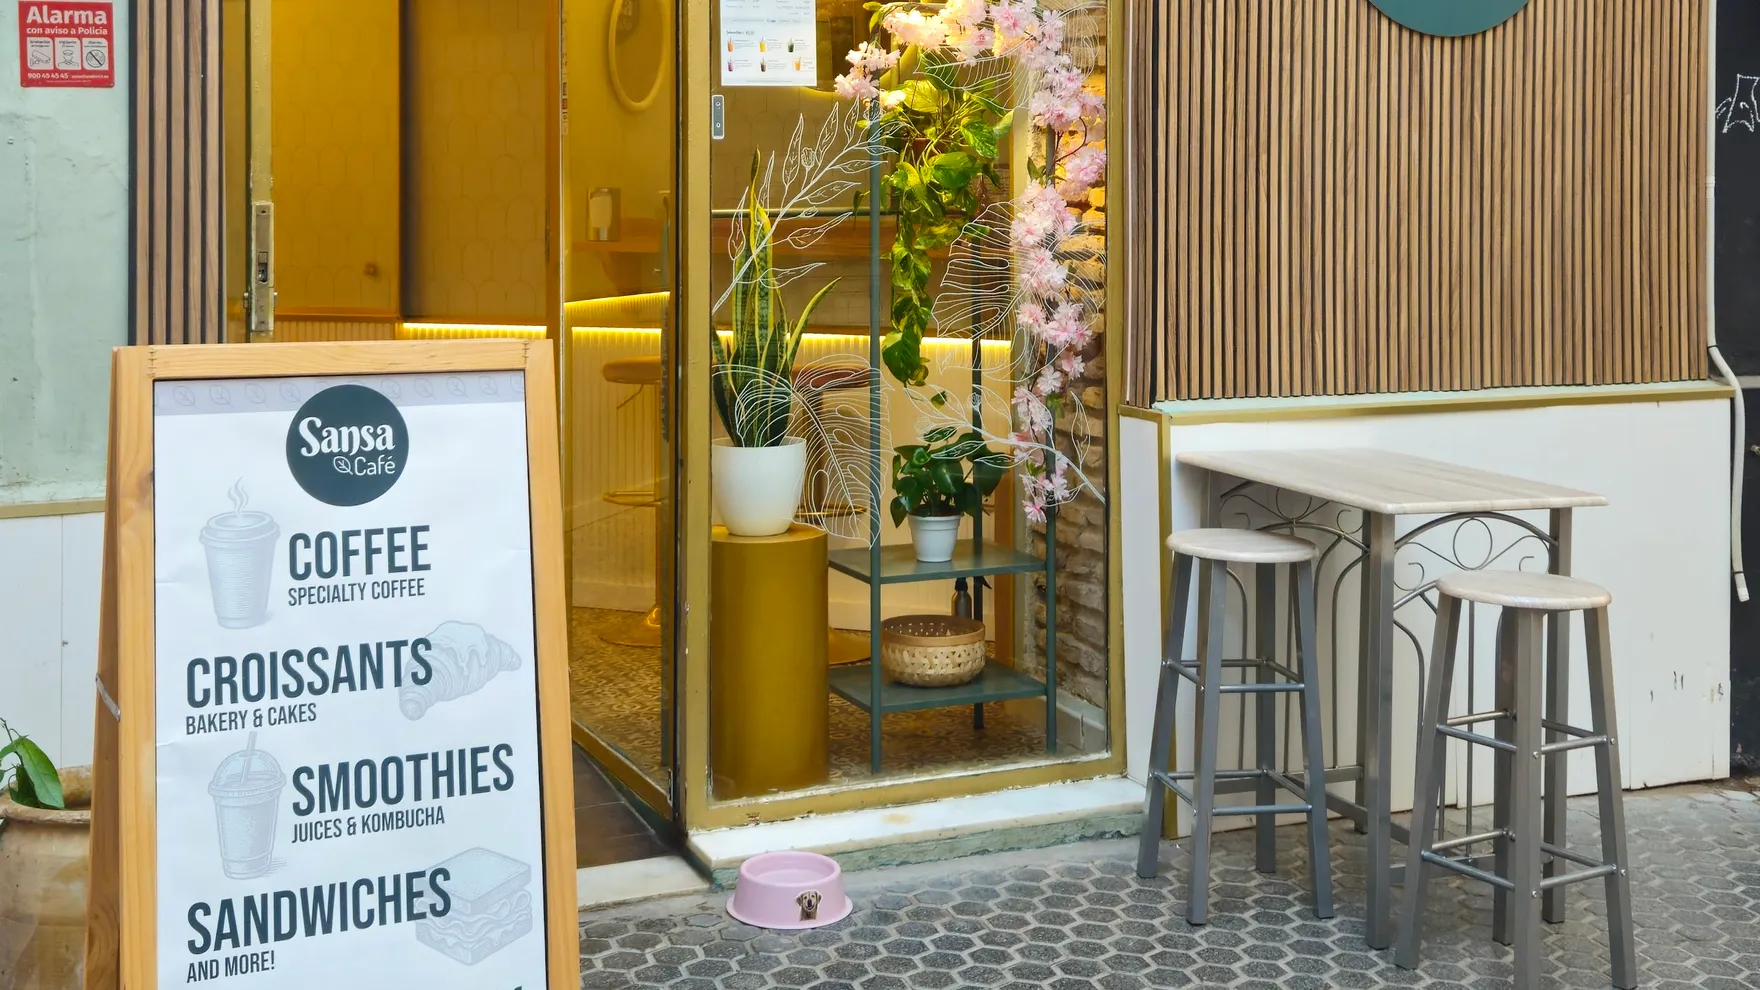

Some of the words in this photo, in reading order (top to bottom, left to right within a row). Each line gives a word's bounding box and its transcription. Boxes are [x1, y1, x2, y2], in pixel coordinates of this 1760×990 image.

[26, 5, 108, 25] Alarma
[26, 26, 43, 34] con
[44, 26, 69, 35] aviso
[70, 27, 77, 35] a
[78, 26, 108, 35] Policía
[298, 416, 396, 457] Sansa
[354, 454, 396, 476] Café
[288, 524, 432, 581] COFFEE
[288, 582, 367, 607] SPECIALTY
[371, 577, 426, 600] COFFEE
[186, 637, 433, 709] CROISSANTS
[186, 709, 249, 736] BAKERY
[253, 708, 264, 728] &
[267, 702, 317, 727] CAKES
[292, 743, 515, 817] SMOOTHIES
[291, 816, 343, 844] JUICES
[346, 816, 358, 836] &
[361, 806, 446, 834] KOMBUCHA
[187, 867, 452, 955] SANDWICHES
[187, 958, 220, 984] AND
[224, 949, 276, 978] MORE!
